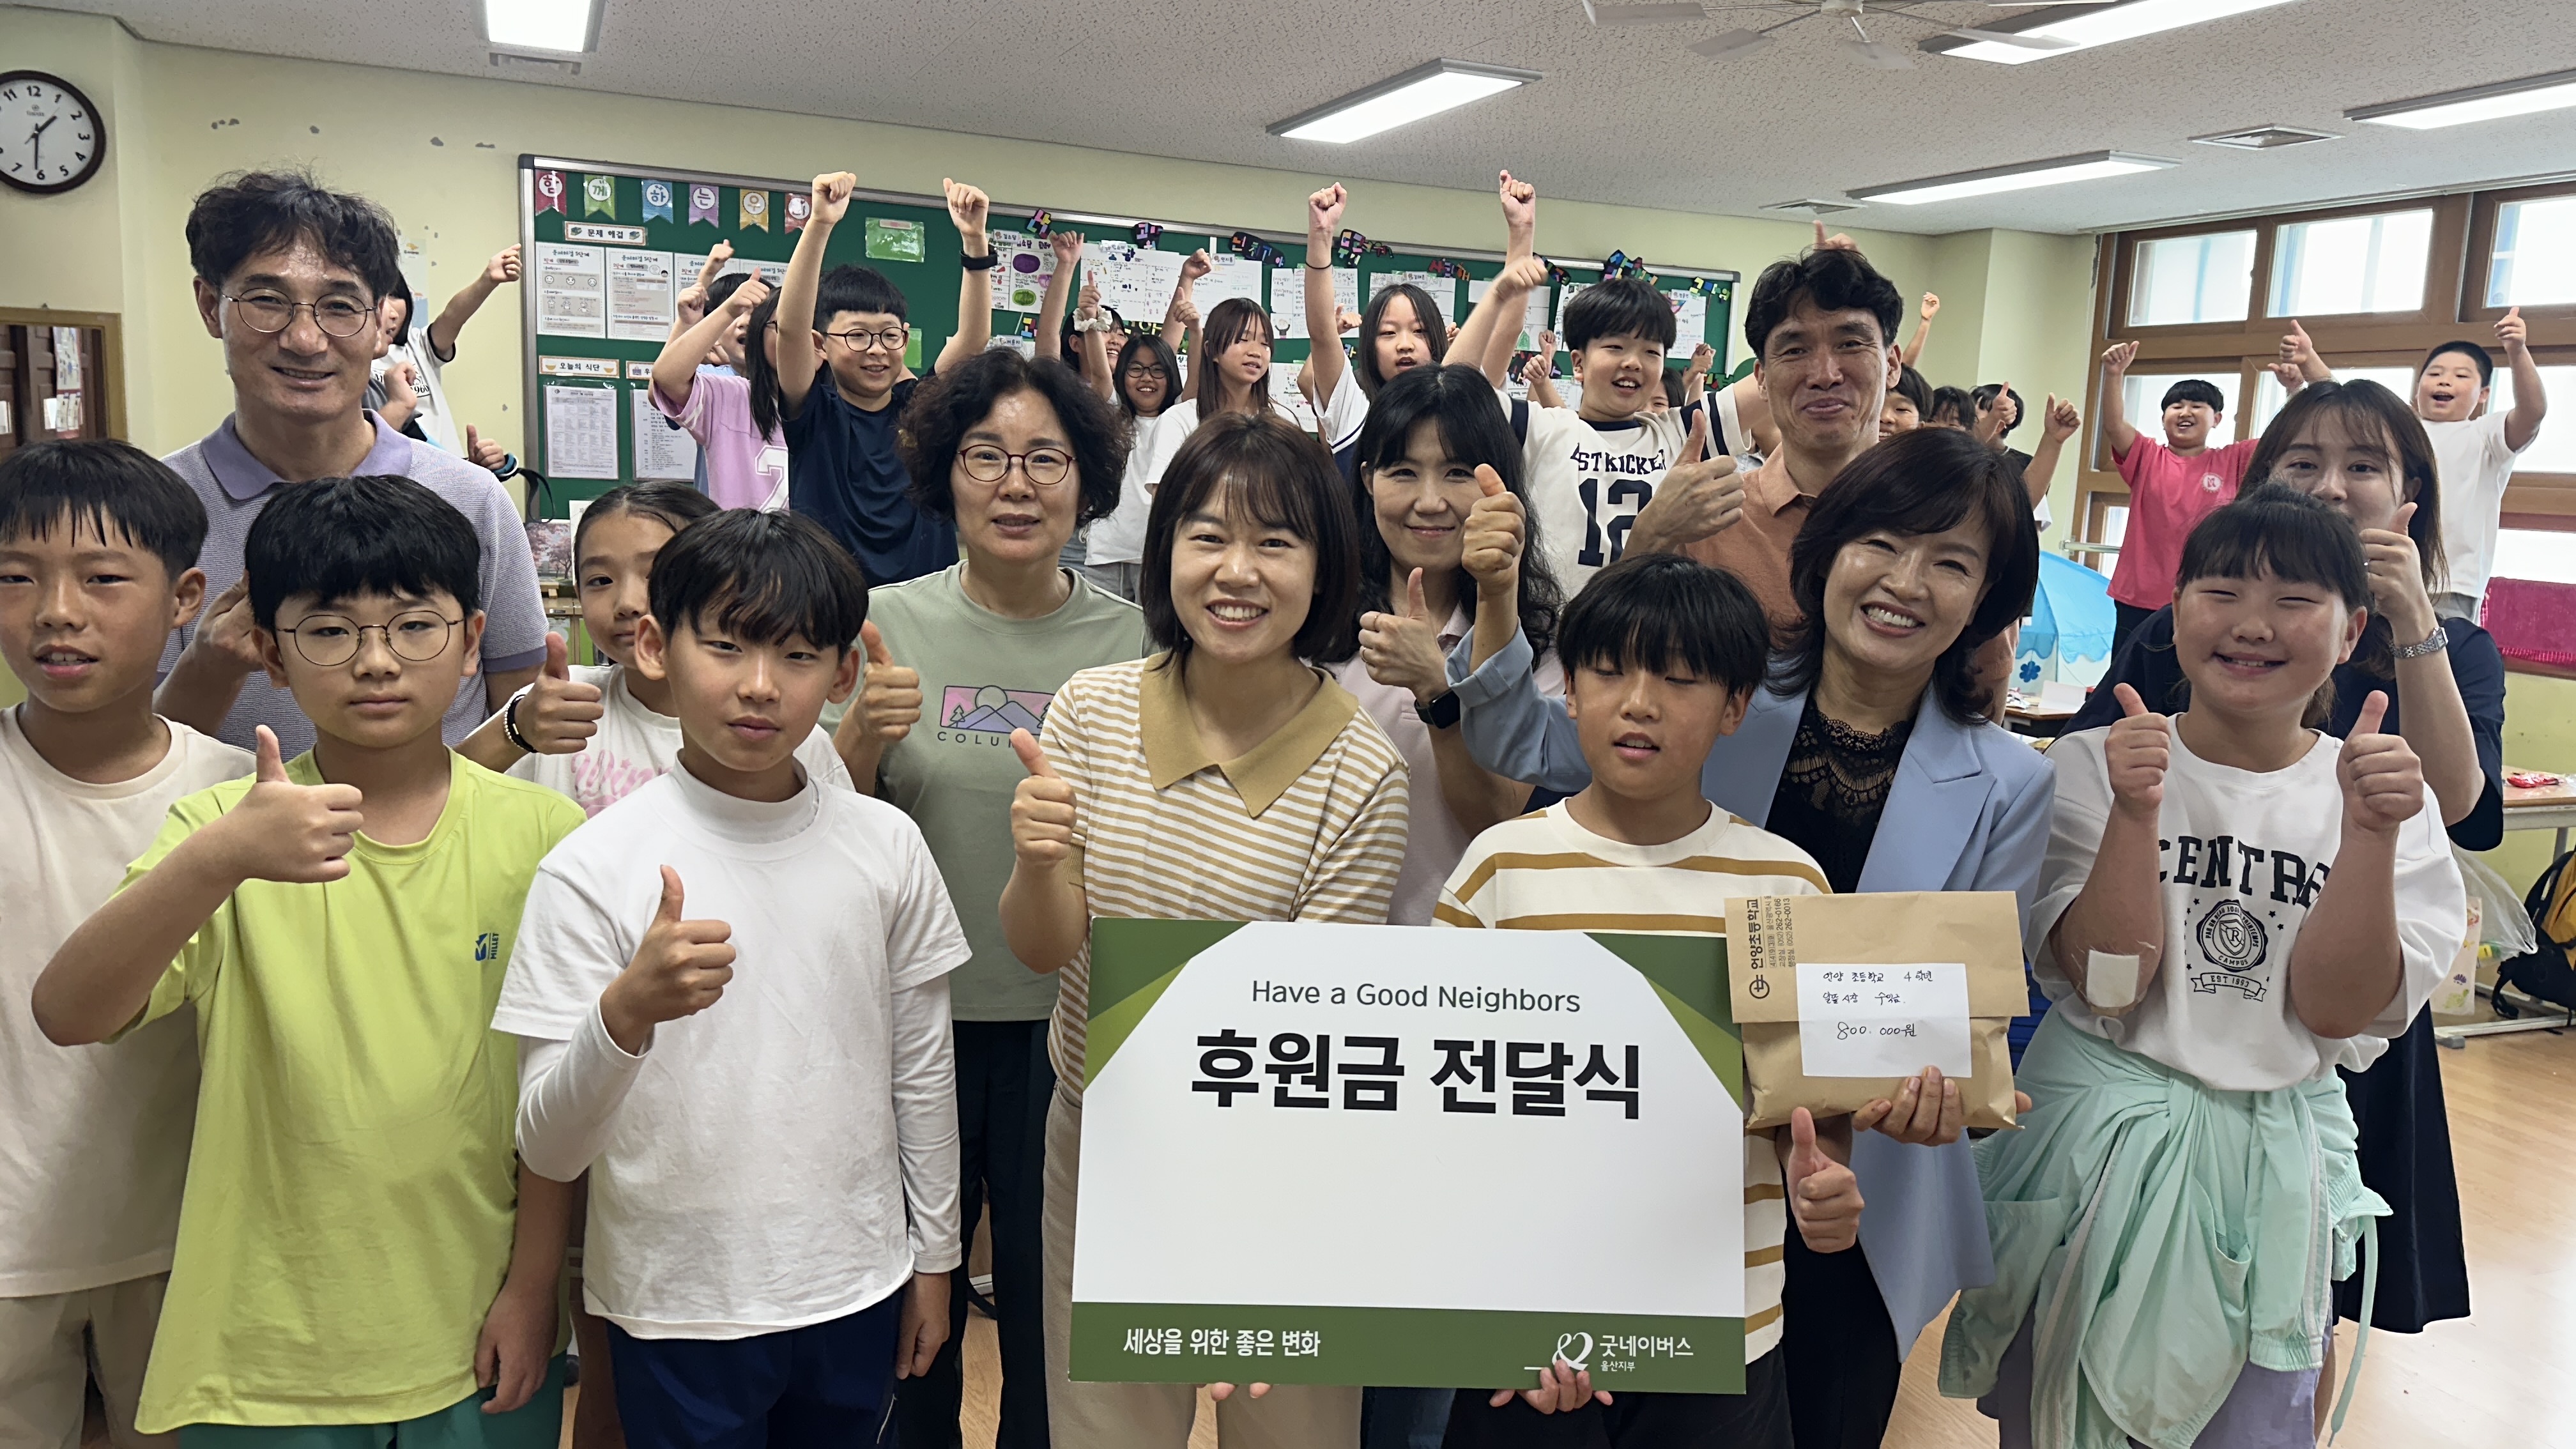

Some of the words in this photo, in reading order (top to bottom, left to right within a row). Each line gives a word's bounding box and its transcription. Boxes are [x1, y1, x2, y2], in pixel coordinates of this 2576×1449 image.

[4, 89, 17, 101] 11
[27, 86, 41, 97] 12
[55, 94, 61, 103] 1
[70, 111, 82, 120] 2
[75, 152, 86, 161] 4
[12, 162, 22, 172] 7
[59, 165, 68, 176] 5
[37, 170, 45, 180] 6
[587, 228, 603, 238] 문제
[608, 229, 624, 240] 해결
[560, 362, 581, 371] 오늘의
[1578, 478, 1652, 567] 12
[1747, 899, 1763, 969] 언양초등학교
[2230, 930, 2241, 942] R
[490, 933, 499, 959] MILLET
[2218, 955, 2248, 966] CAMPUS
[1823, 971, 1844, 982] 언양
[1851, 972, 1884, 983] 초등학교
[1903, 971, 1912, 982] 4
[1915, 970, 1933, 981] 학년
[2232, 977, 2249, 988] 1993
[1253, 981, 1320, 1004] Have
[1331, 987, 1346, 1004] a
[1356, 983, 1427, 1007] Good
[1438, 986, 1581, 1013] Neighbors
[1823, 991, 1839, 1004] 알뜰
[1842, 992, 1859, 1003] 시장
[1192, 1029, 1404, 1110] 후원금
[1430, 1039, 1639, 1119] 전달식
[1123, 1328, 1183, 1355] 세상을
[1190, 1328, 1229, 1355] 위한
[1236, 1330, 1275, 1356] 좋은
[1282, 1330, 1321, 1357] 변화
[1600, 1335, 1694, 1358] 굿네이버스
[1600, 1361, 1636, 1372] 울산지부
